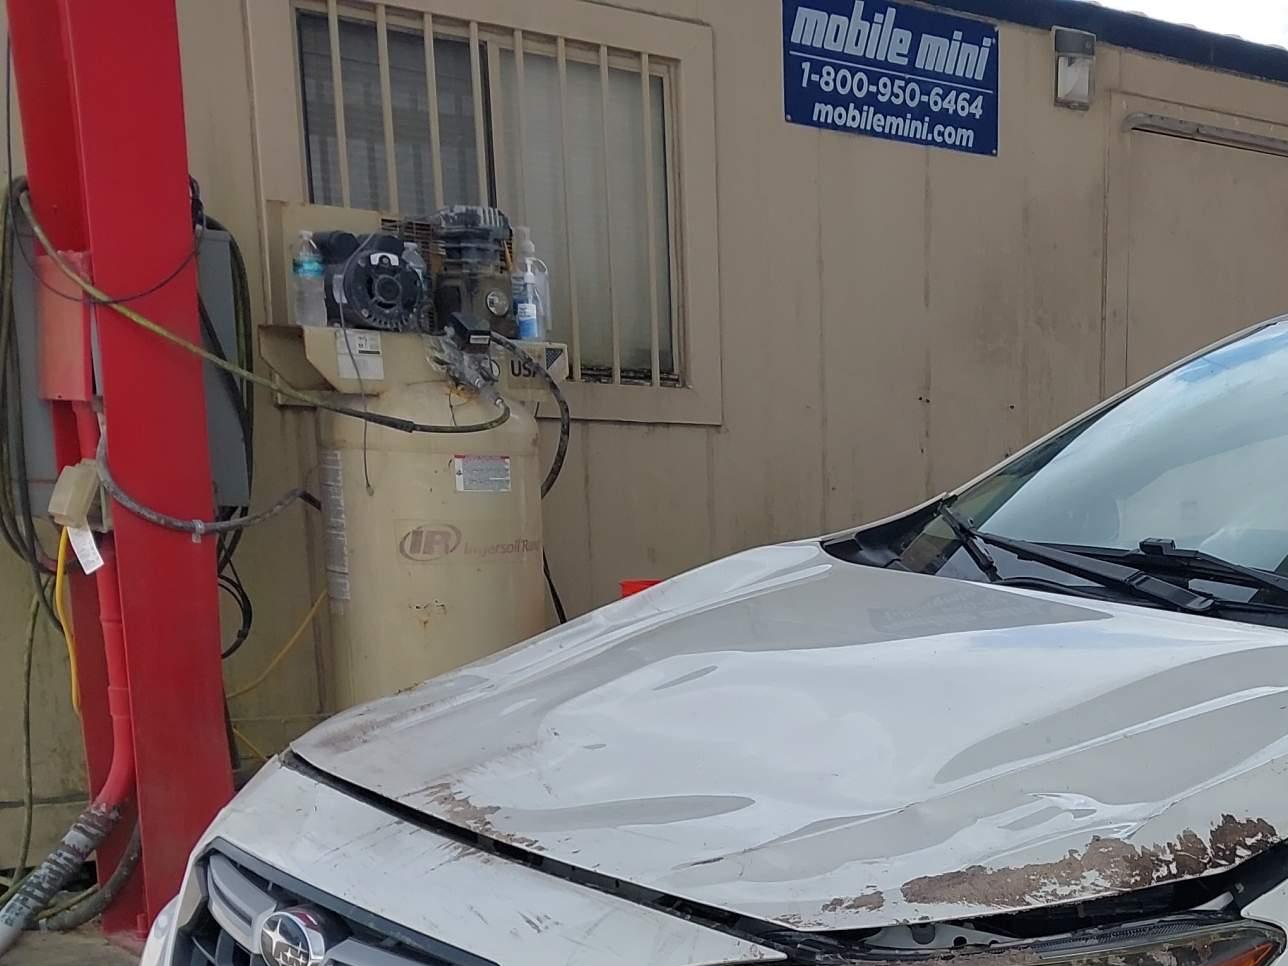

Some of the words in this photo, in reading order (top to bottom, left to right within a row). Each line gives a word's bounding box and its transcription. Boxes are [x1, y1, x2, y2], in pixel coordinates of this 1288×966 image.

[790, 0, 912, 66] mobile
[915, 30, 992, 81] mini
[801, 61, 984, 119] 1-800-950-6464
[812, 102, 975, 147] mobilemini.com
